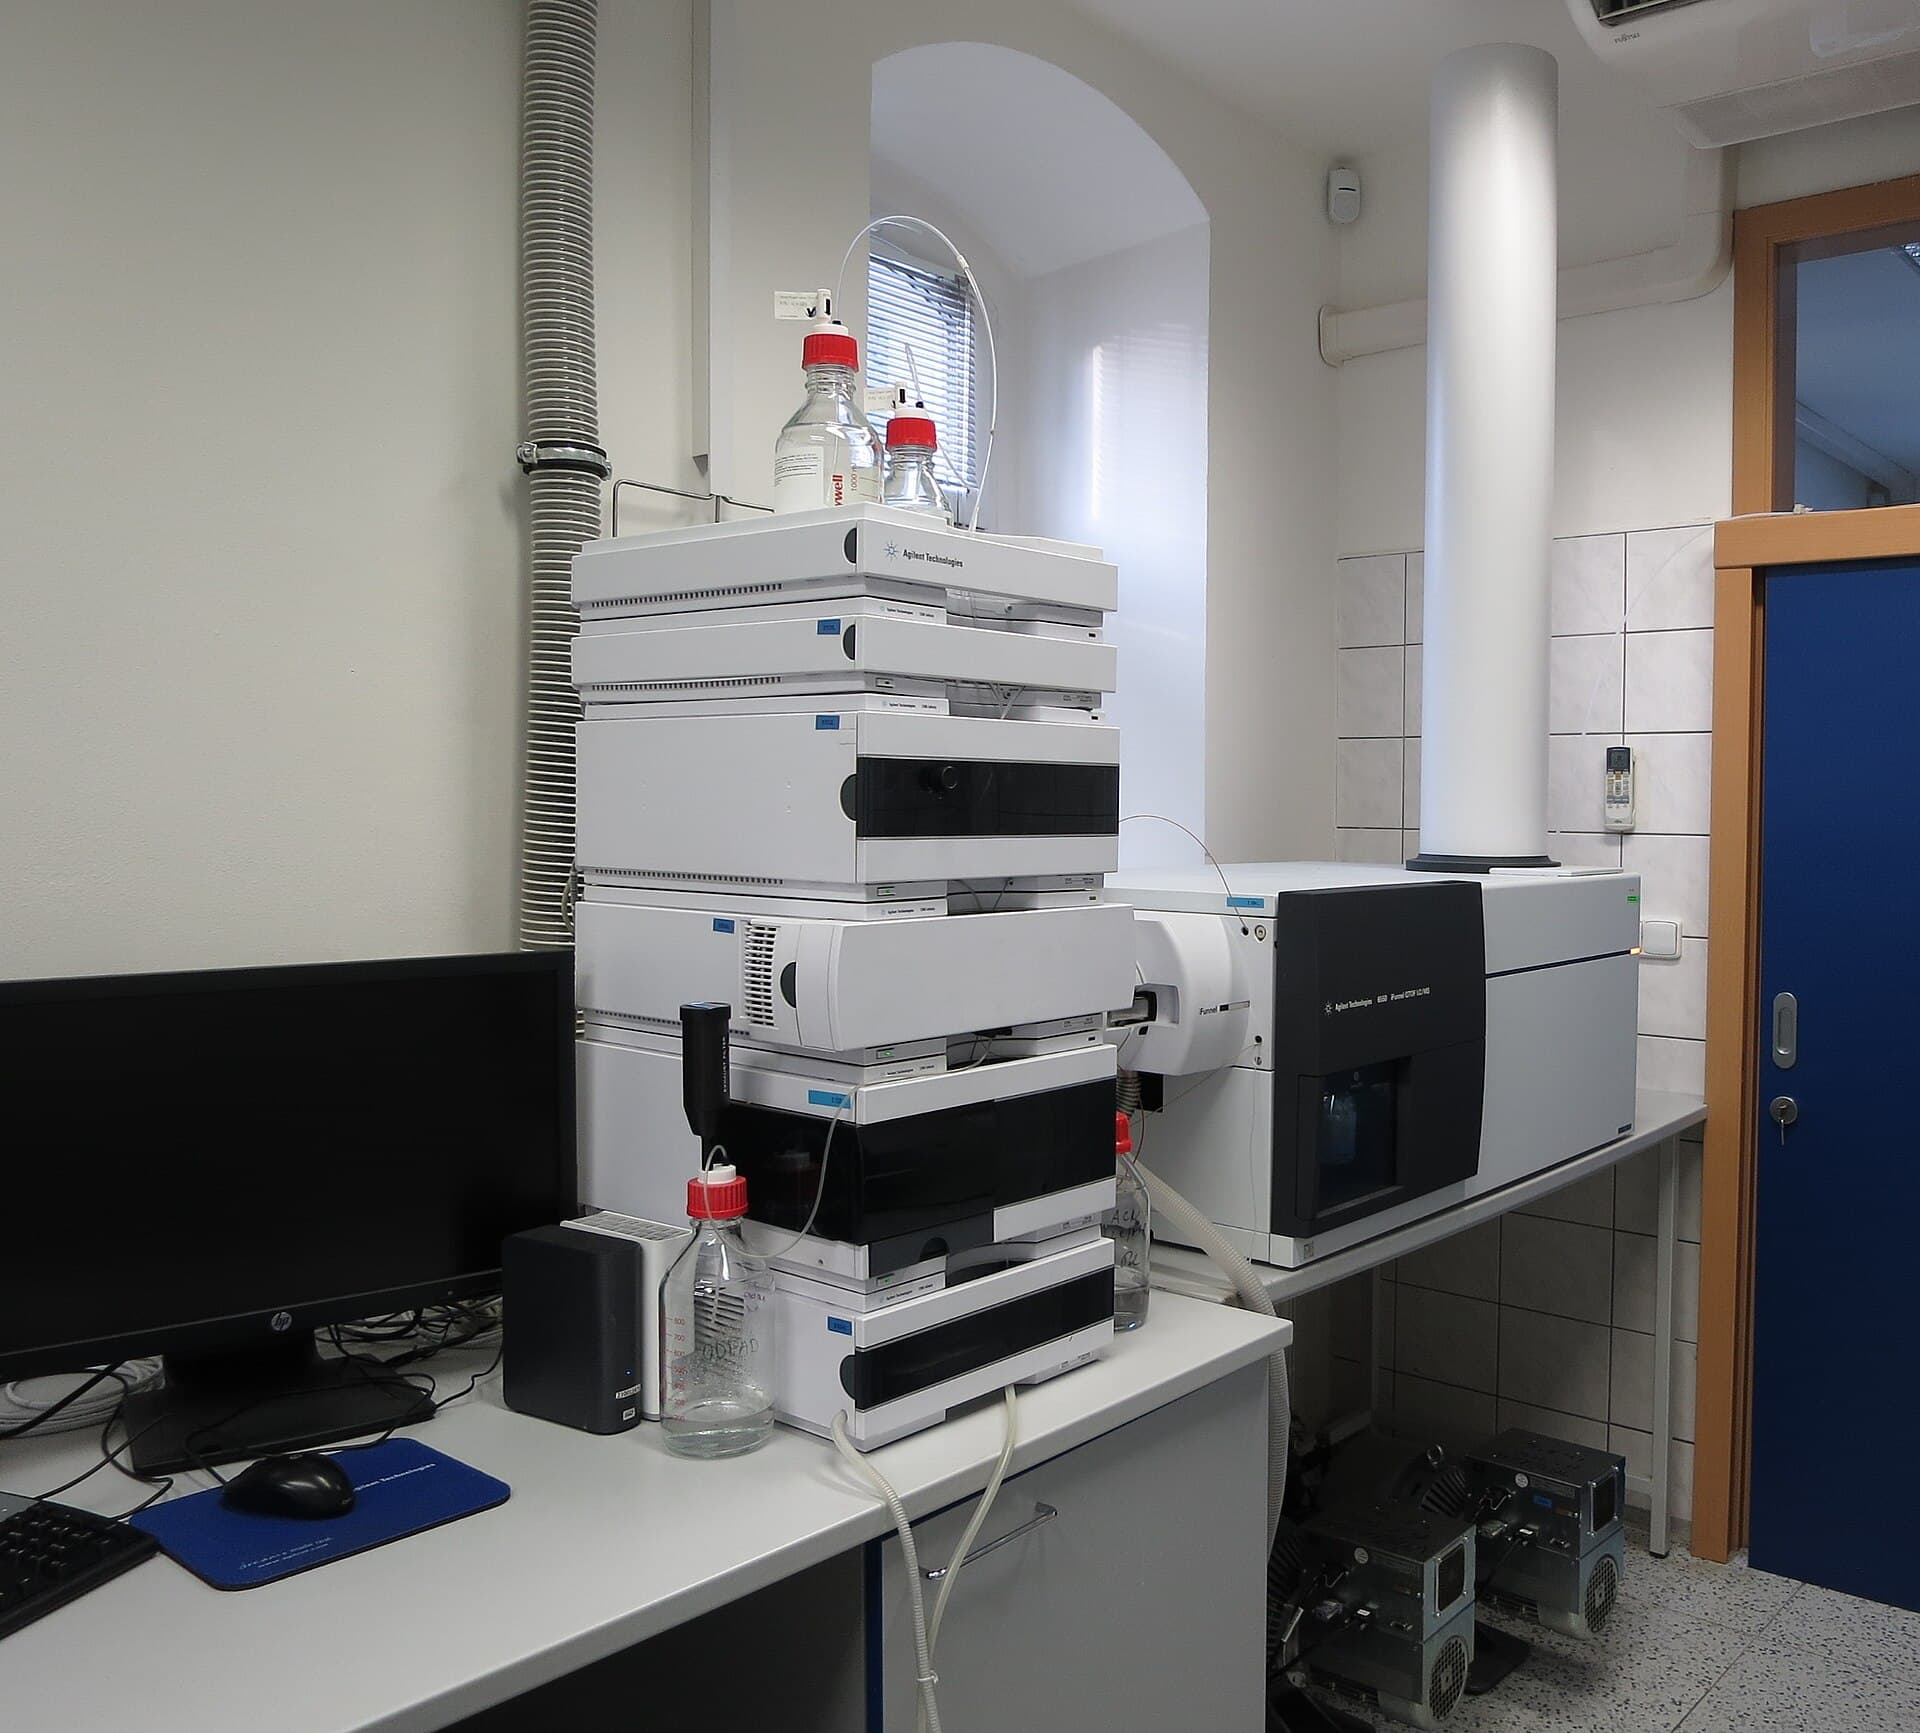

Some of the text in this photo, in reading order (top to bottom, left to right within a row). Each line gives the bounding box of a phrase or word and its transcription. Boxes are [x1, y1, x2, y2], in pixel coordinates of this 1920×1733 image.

[903, 549, 963, 568] Agilent Technologies
[1335, 1002, 1349, 1012] Agilent
[1349, 999, 1373, 1008] Technologies
